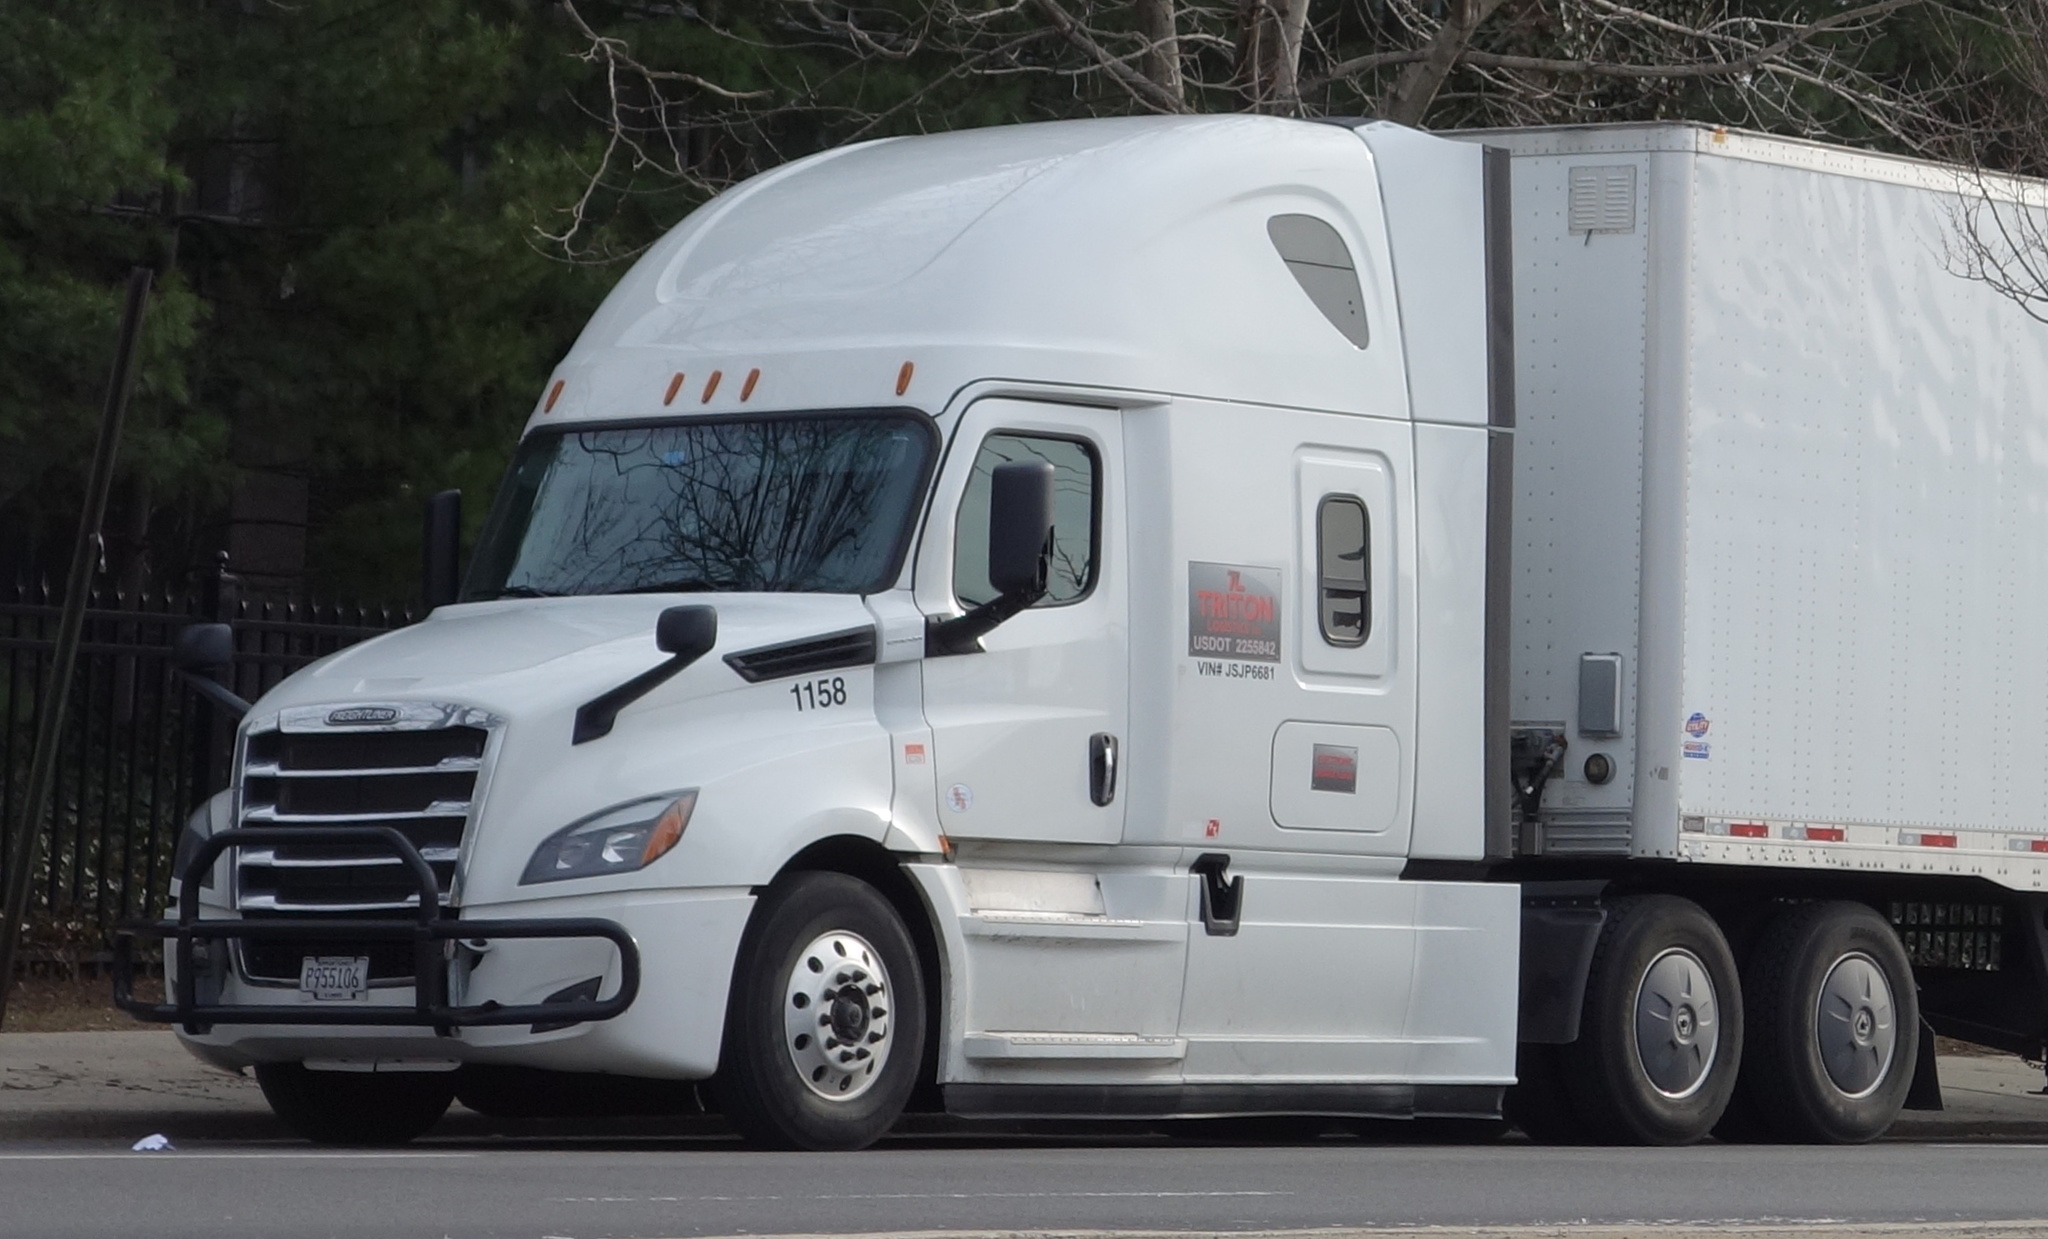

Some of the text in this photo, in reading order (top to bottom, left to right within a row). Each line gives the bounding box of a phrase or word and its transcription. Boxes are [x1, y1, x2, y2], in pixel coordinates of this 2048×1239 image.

[1196, 590, 1274, 622] TRITON
[1193, 635, 1276, 656] USDOT 2255842
[1197, 661, 1275, 680] VIN# JSJP6681
[789, 676, 847, 712] 1158
[305, 966, 360, 989] P955106
